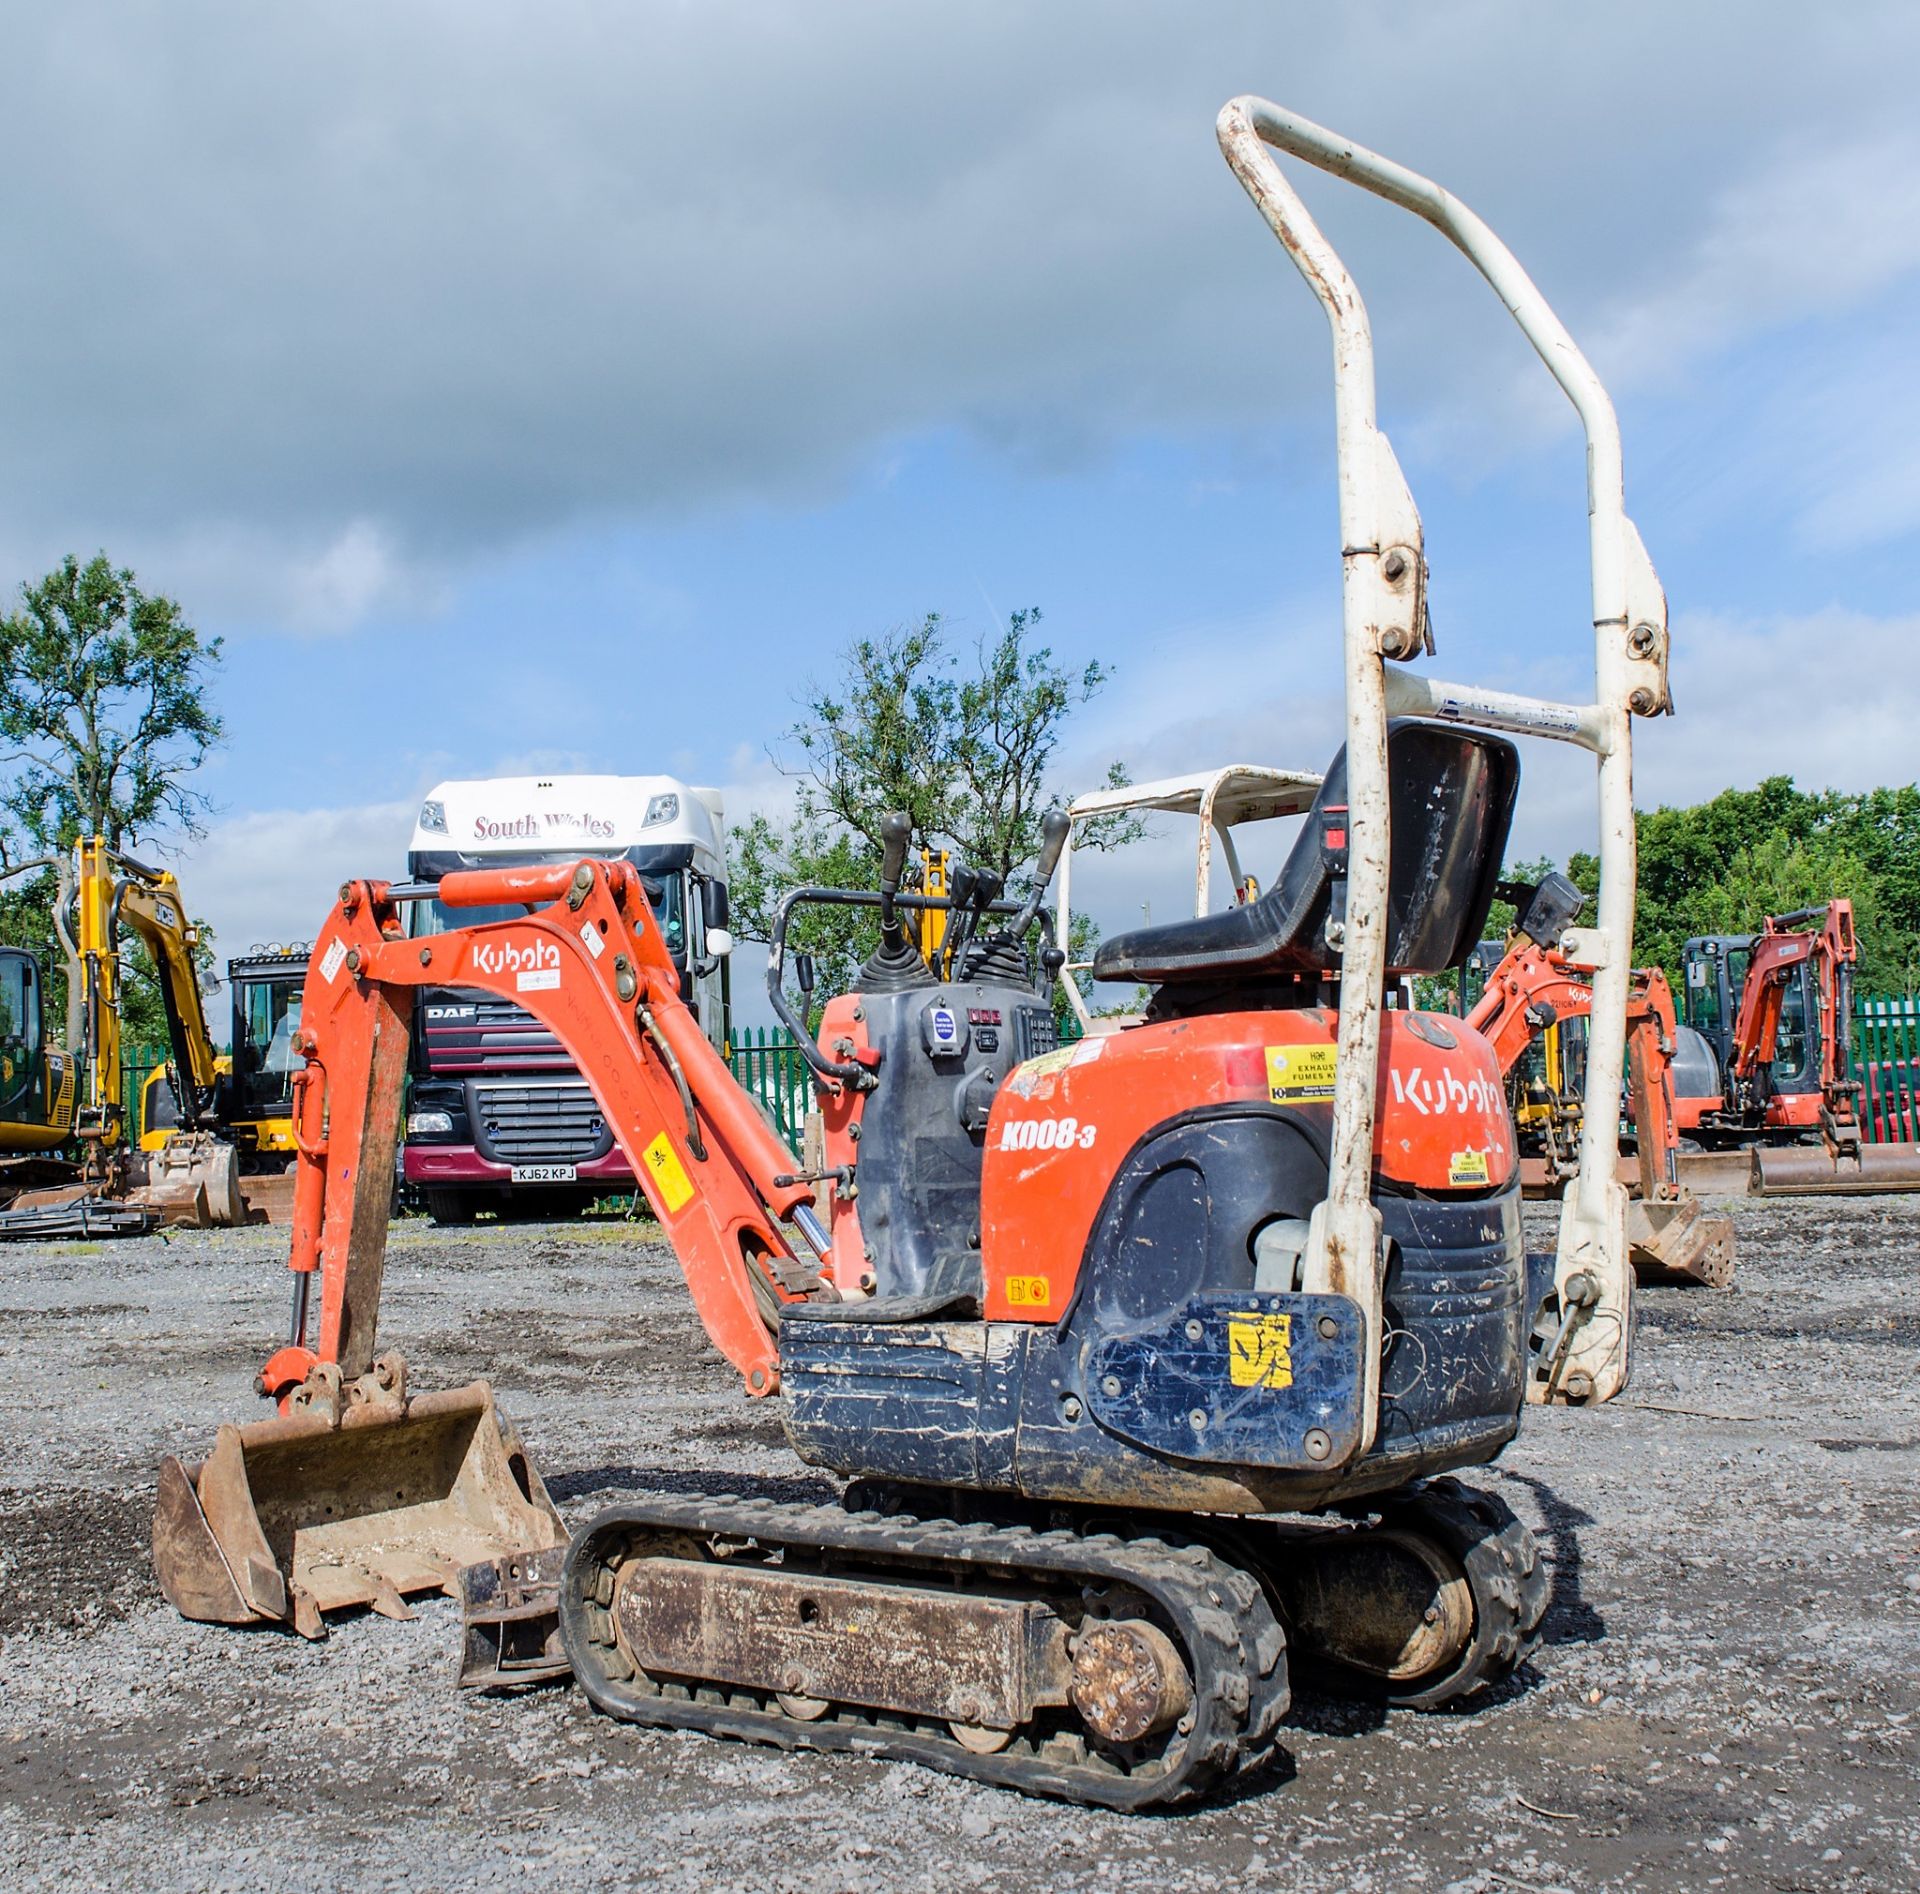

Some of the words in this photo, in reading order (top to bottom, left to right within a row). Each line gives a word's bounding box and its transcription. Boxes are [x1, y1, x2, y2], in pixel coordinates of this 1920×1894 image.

[474, 814, 540, 840] South
[155, 901, 174, 927] JCB
[473, 938, 560, 974] Kubota
[1568, 986, 1592, 1003] Kub
[427, 1008, 475, 1019] DAF
[1391, 1067, 1502, 1115] Kubota
[1000, 1117, 1097, 1151] K008-3
[519, 1168, 549, 1180] KJ62
[552, 1167, 574, 1179] KPJ
